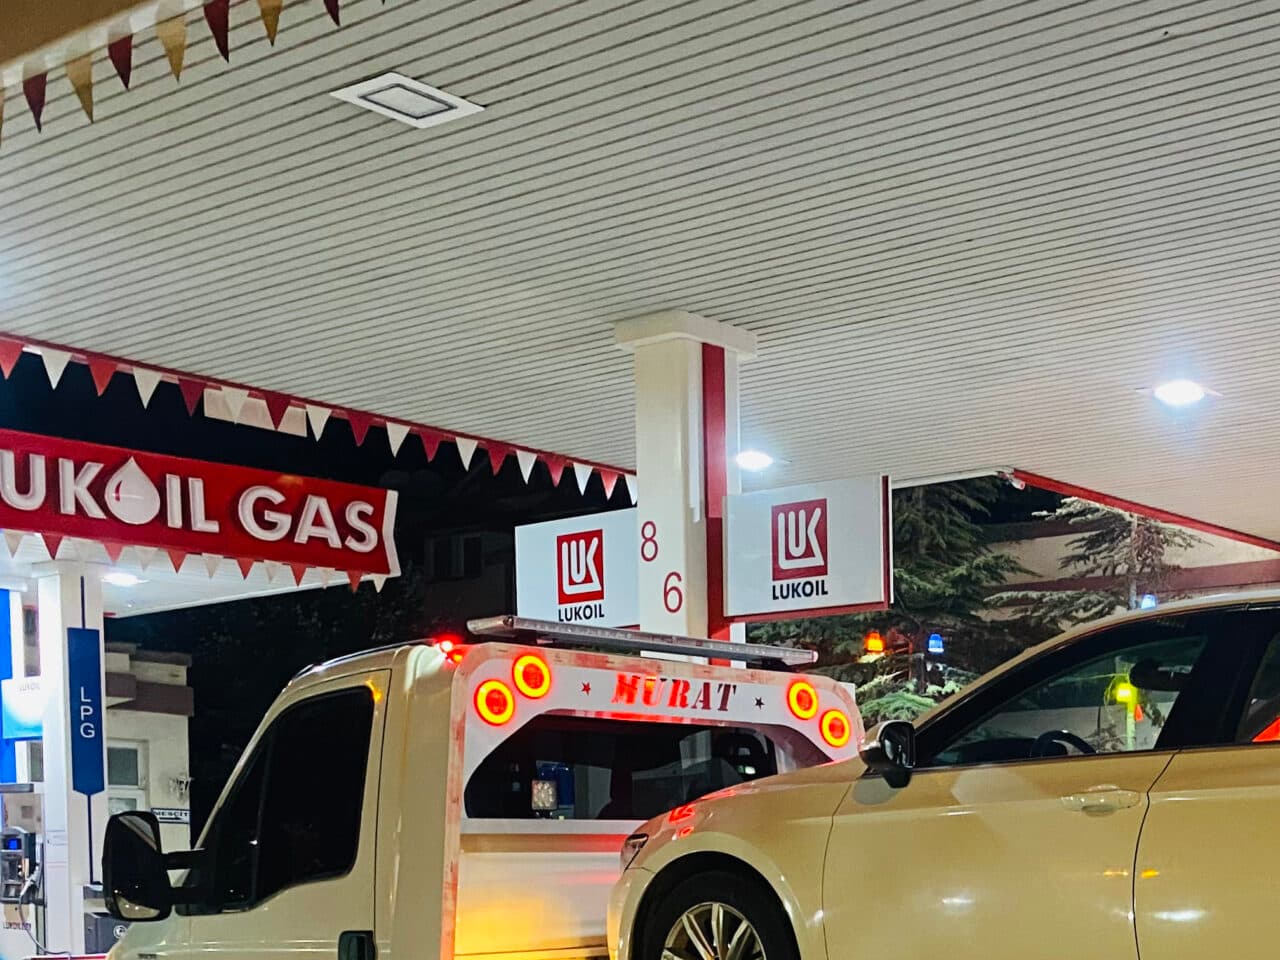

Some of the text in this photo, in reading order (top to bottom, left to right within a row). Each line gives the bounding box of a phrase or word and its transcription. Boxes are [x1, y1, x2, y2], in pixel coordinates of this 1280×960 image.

[237, 484, 380, 553] GAS
[777, 507, 825, 570] LUK
[640, 520, 659, 562] 8
[561, 537, 602, 596] LUK
[663, 571, 684, 614] 6
[772, 579, 829, 601] LUKOIL
[558, 604, 605, 622] LUKOIL
[610, 673, 738, 712] MURAT
